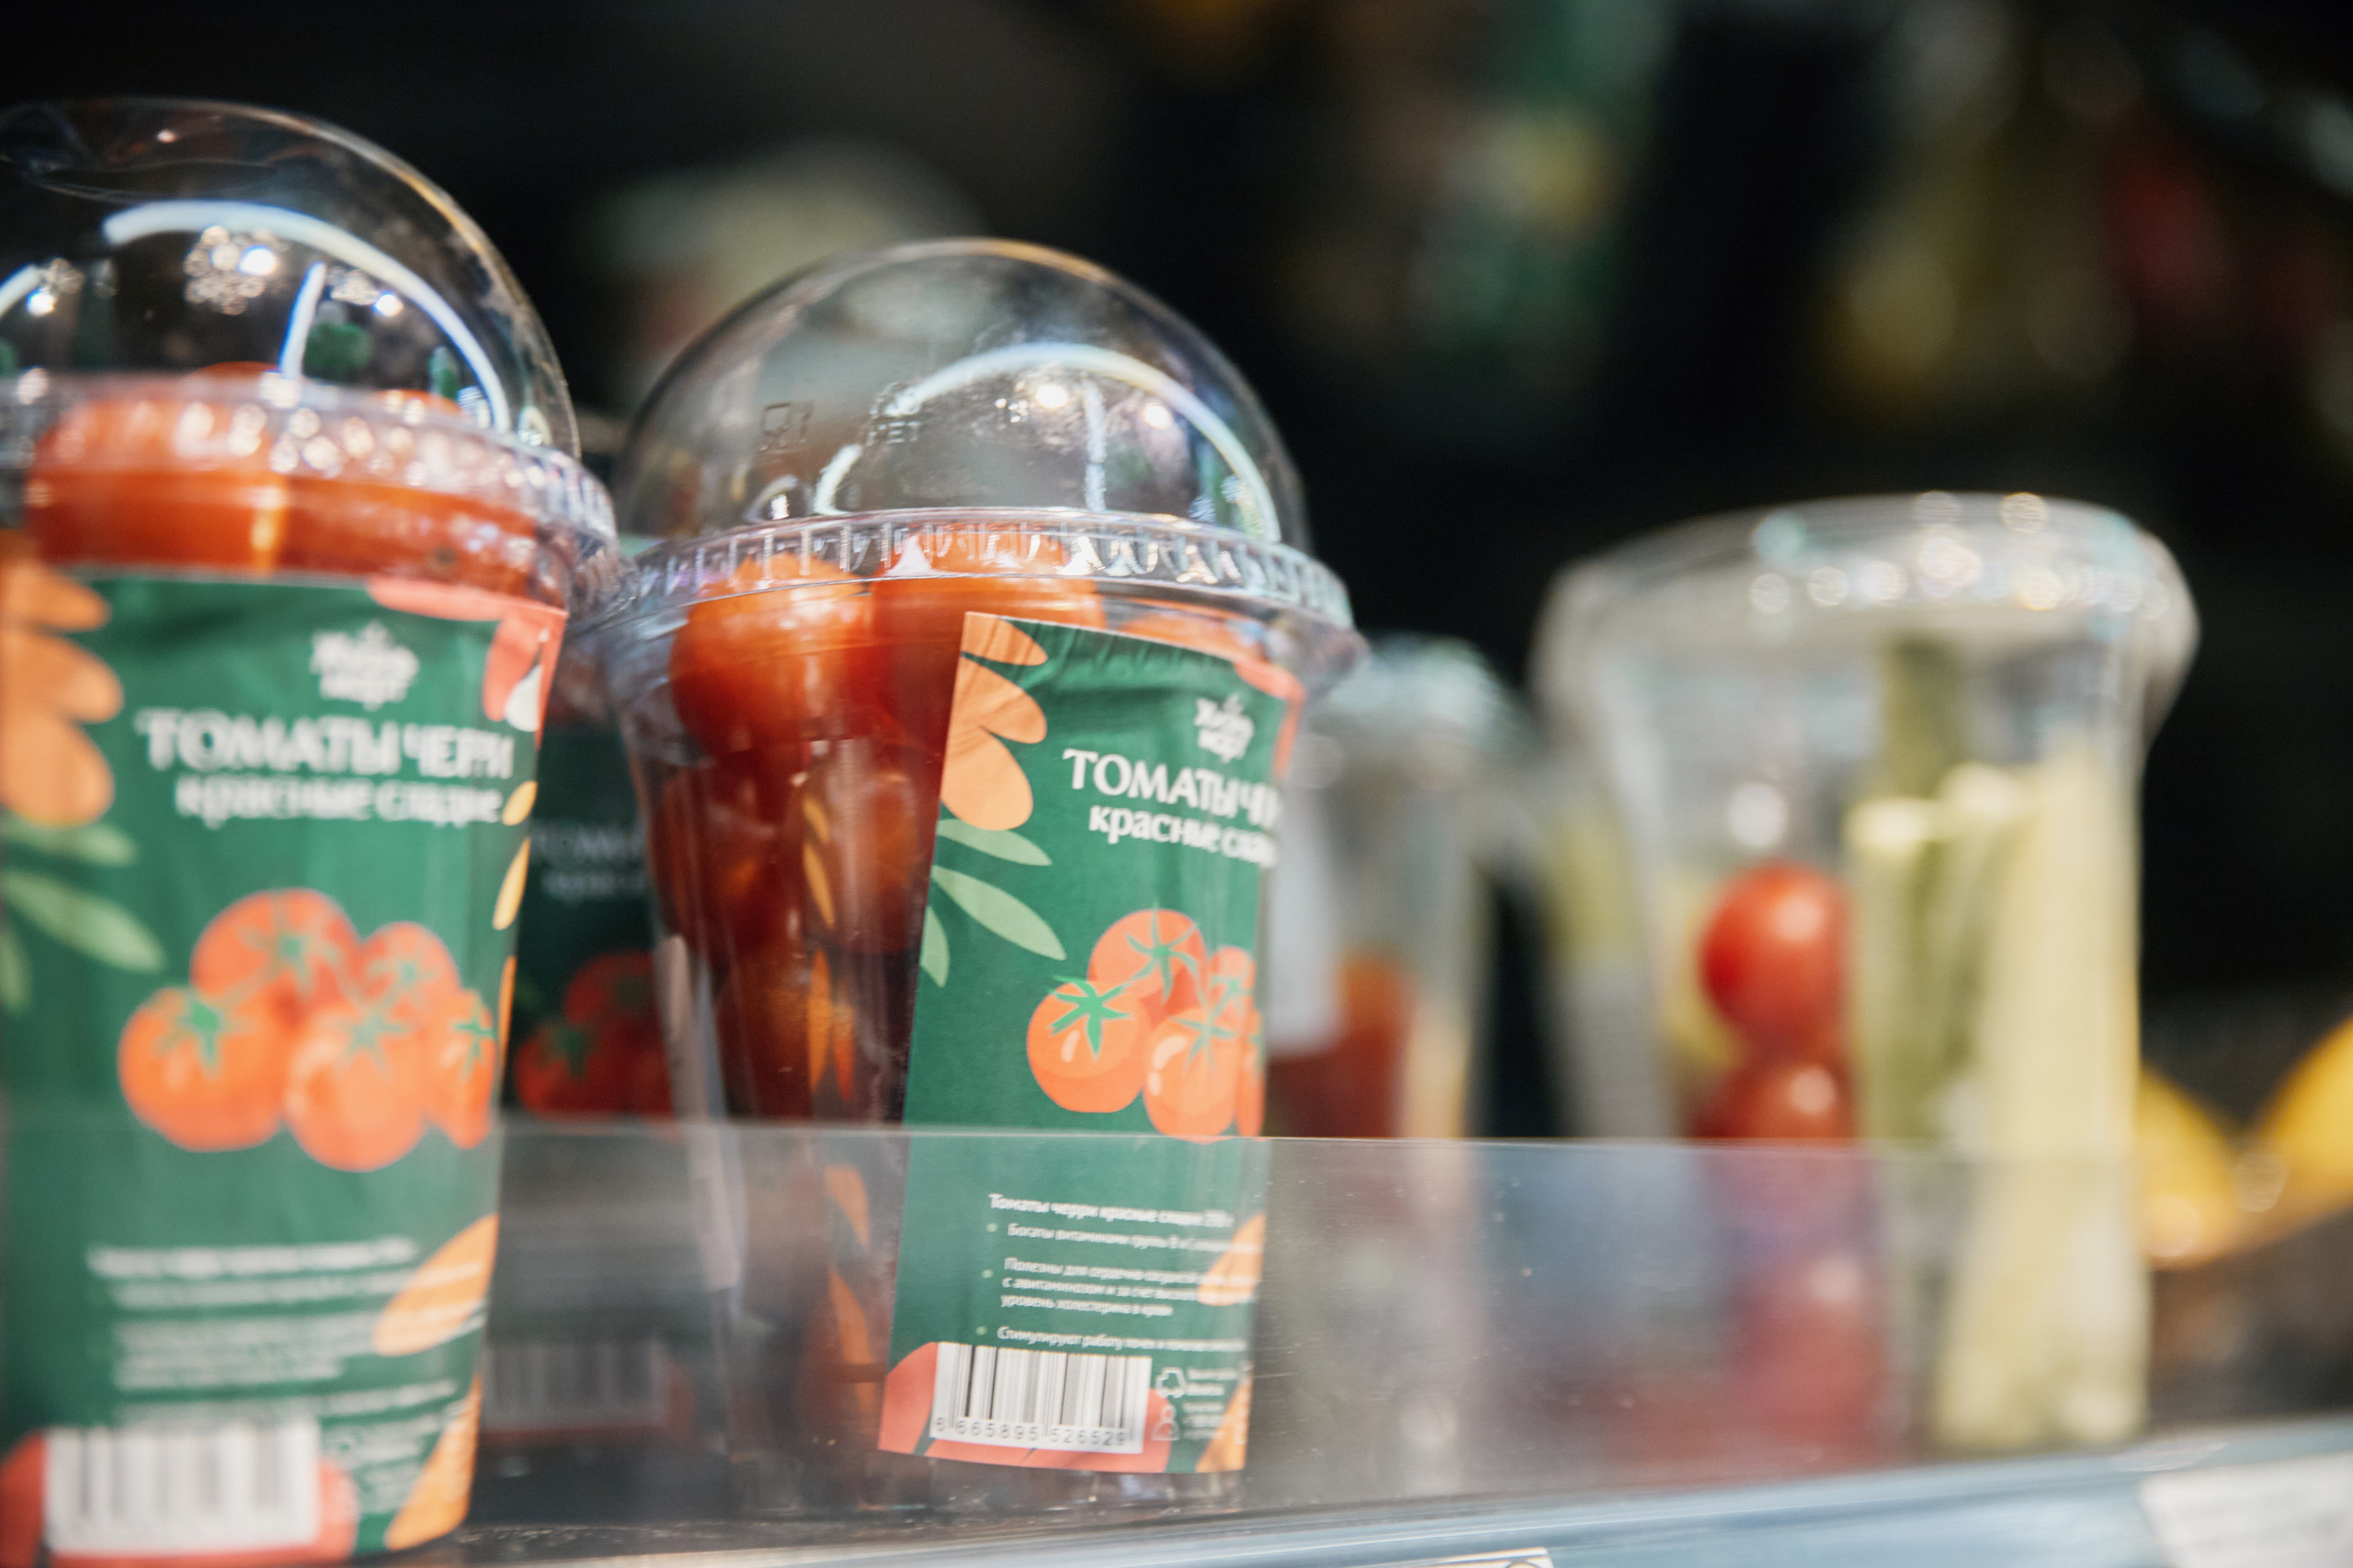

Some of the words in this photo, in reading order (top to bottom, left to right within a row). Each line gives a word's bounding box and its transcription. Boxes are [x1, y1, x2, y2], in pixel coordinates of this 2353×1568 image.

[133, 708, 401, 774] ТОМАТЫ
[1063, 748, 1239, 818] ТОМАТЫ
[1088, 805, 1222, 853] красные
